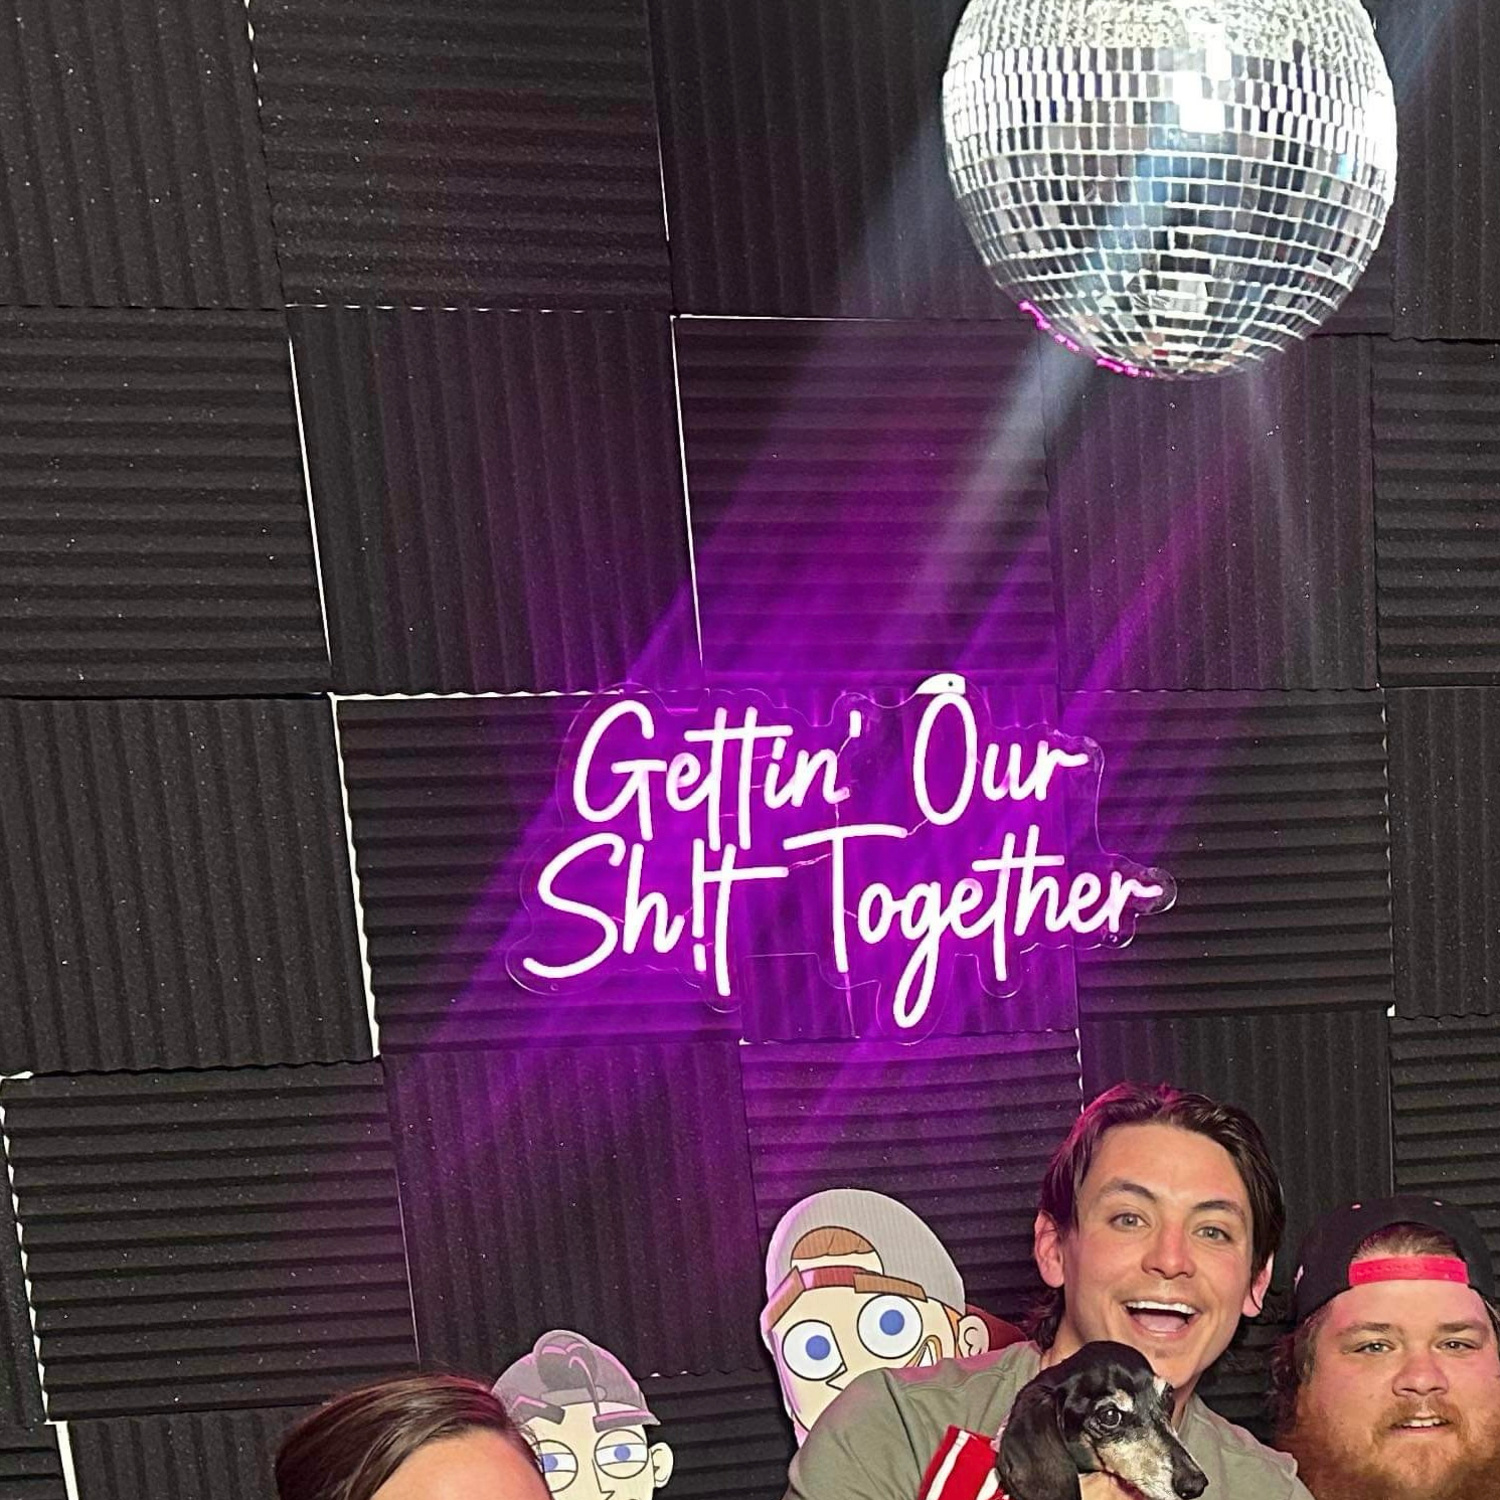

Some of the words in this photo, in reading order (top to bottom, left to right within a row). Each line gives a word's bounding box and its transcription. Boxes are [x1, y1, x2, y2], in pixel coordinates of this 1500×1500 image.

[573, 699, 861, 851] Gettin'
[913, 692, 1088, 825] Our
[783, 824, 1163, 1028] Together
